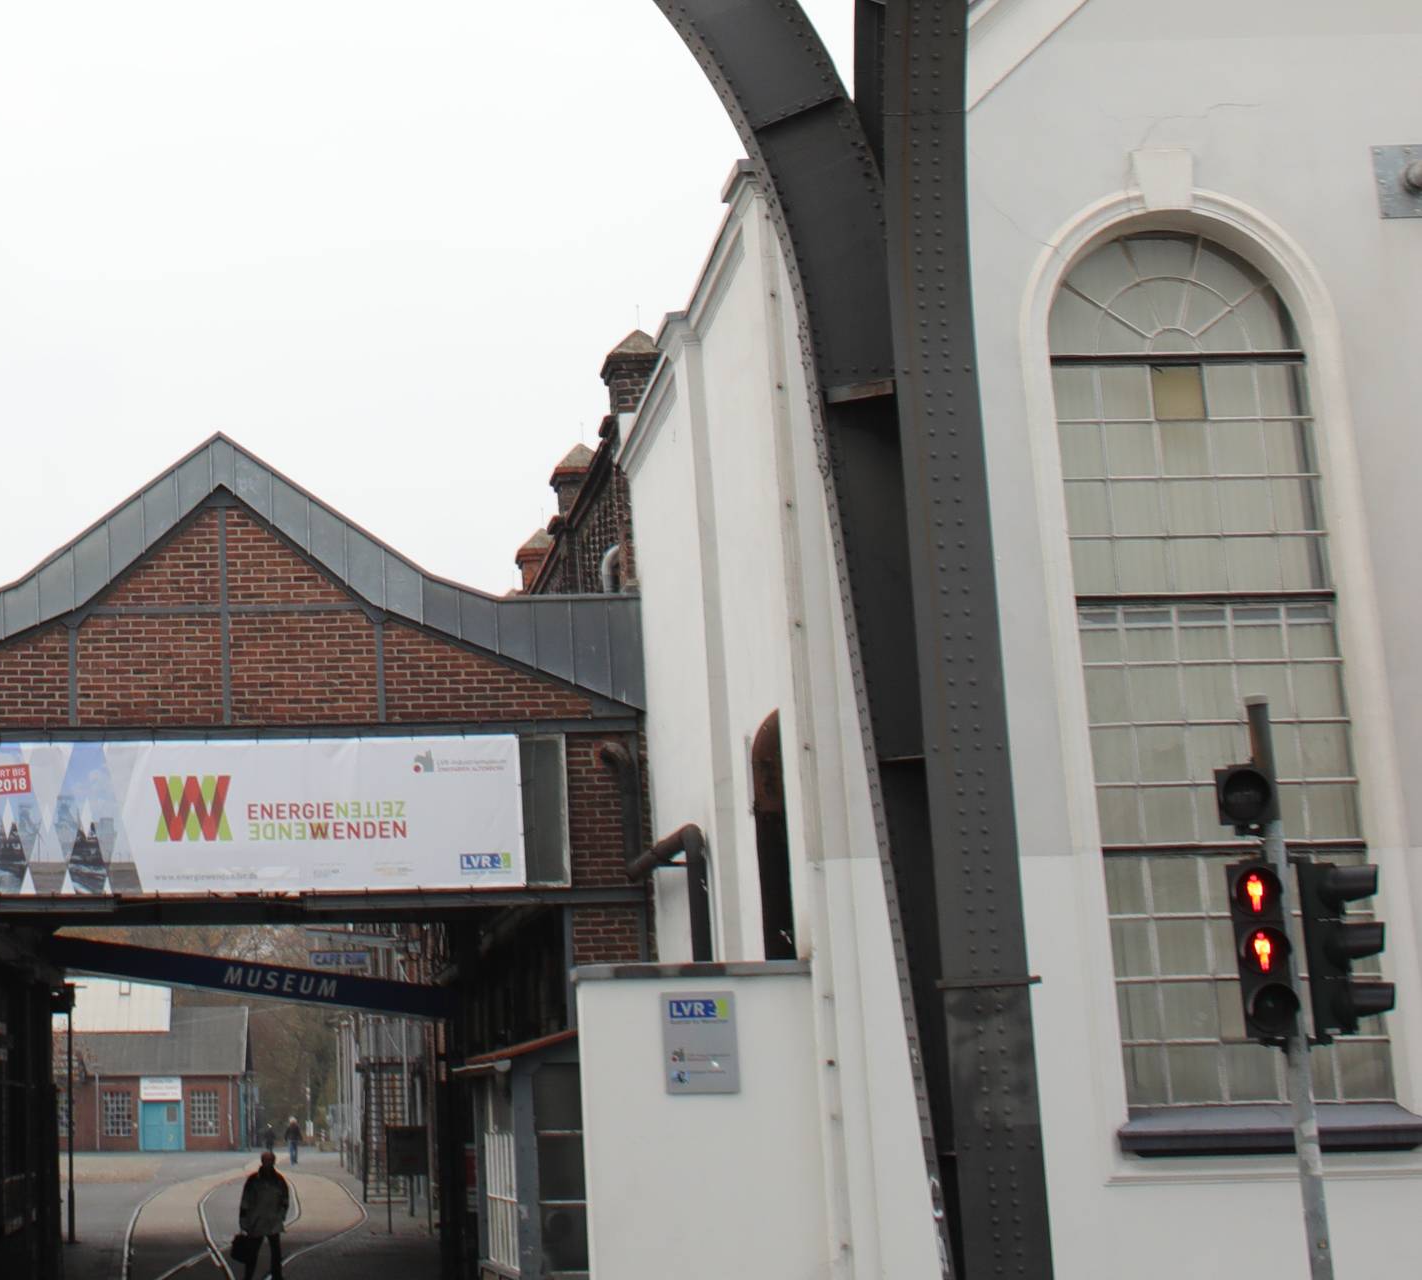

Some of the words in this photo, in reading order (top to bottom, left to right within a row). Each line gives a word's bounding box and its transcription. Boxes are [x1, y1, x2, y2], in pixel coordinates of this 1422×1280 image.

[12, 767, 26, 777] BIS
[461, 855, 492, 868] LVR
[223, 965, 338, 997] MUSEUM
[671, 1001, 706, 1017] LVR
